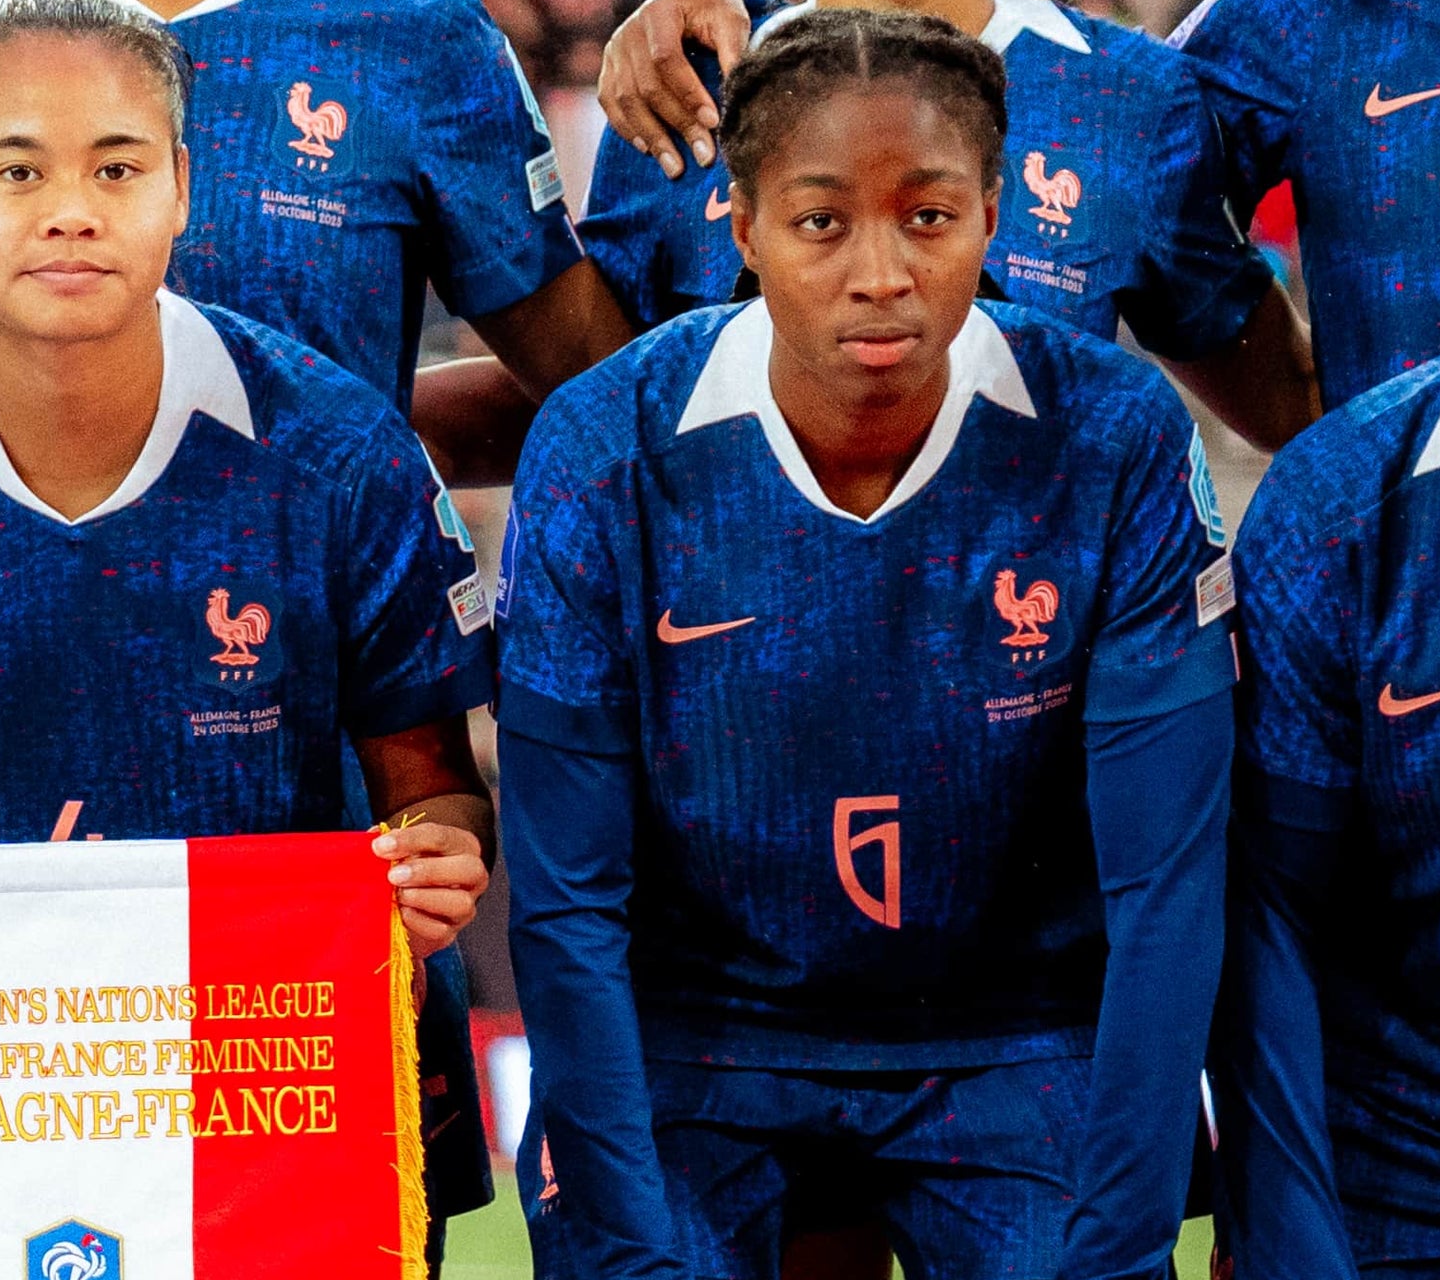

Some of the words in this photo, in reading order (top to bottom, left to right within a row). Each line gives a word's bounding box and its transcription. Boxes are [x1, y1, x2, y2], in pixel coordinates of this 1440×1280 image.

[1012, 650, 1046, 663] FFF
[220, 671, 254, 681] FFF
[190, 711, 240, 723] ALLEMAGNE
[250, 705, 281, 720] FRANCE
[194, 725, 206, 736] 24
[210, 723, 249, 735] OCTOBRE
[252, 718, 278, 733] 2025
[834, 795, 900, 928] 6
[56, 984, 198, 1023] NATIONS
[204, 981, 334, 1020] LEAGUE
[0, 1040, 147, 1078] FRANCE
[153, 1036, 334, 1075] FEMININE
